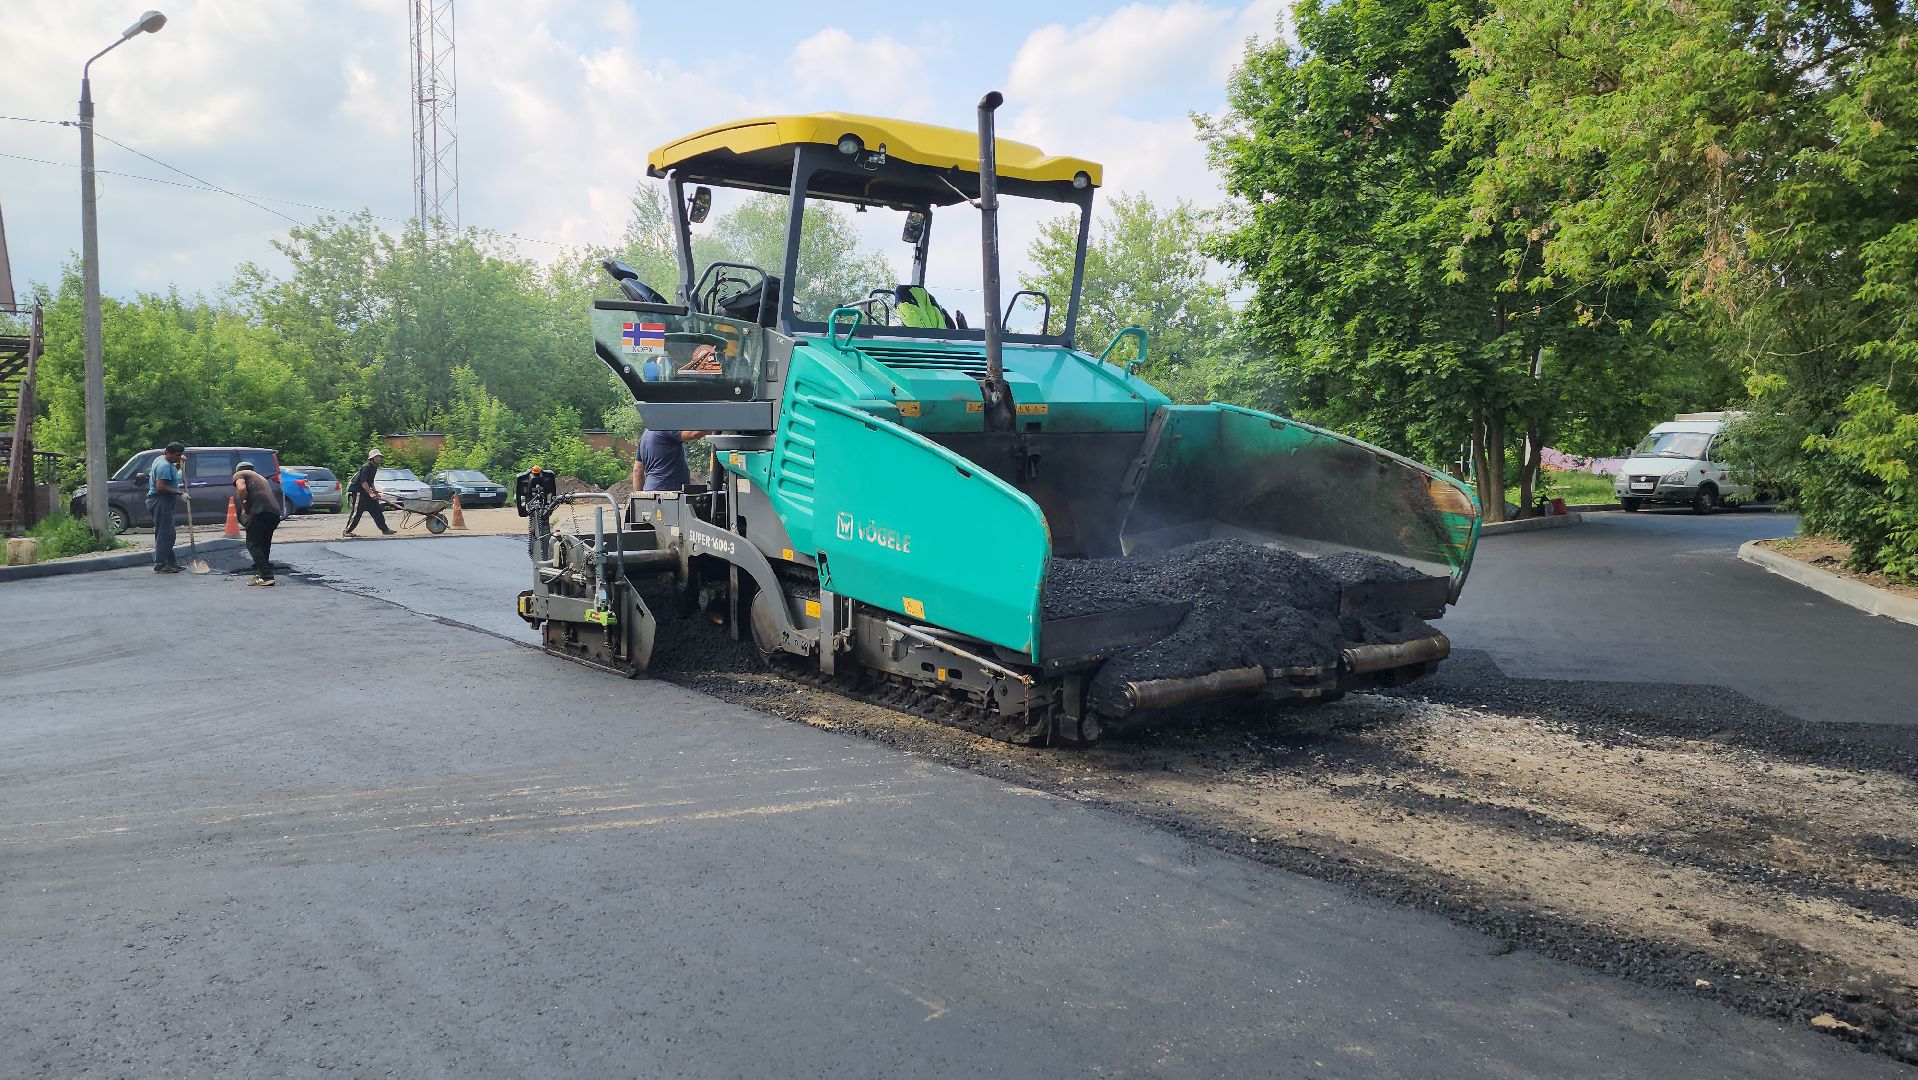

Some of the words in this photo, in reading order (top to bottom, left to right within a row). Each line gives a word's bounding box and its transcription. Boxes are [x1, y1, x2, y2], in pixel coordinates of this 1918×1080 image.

[689, 530, 710, 547] SUPER
[711, 537, 735, 555] 1600-3
[858, 519, 911, 553] VÖGELE
